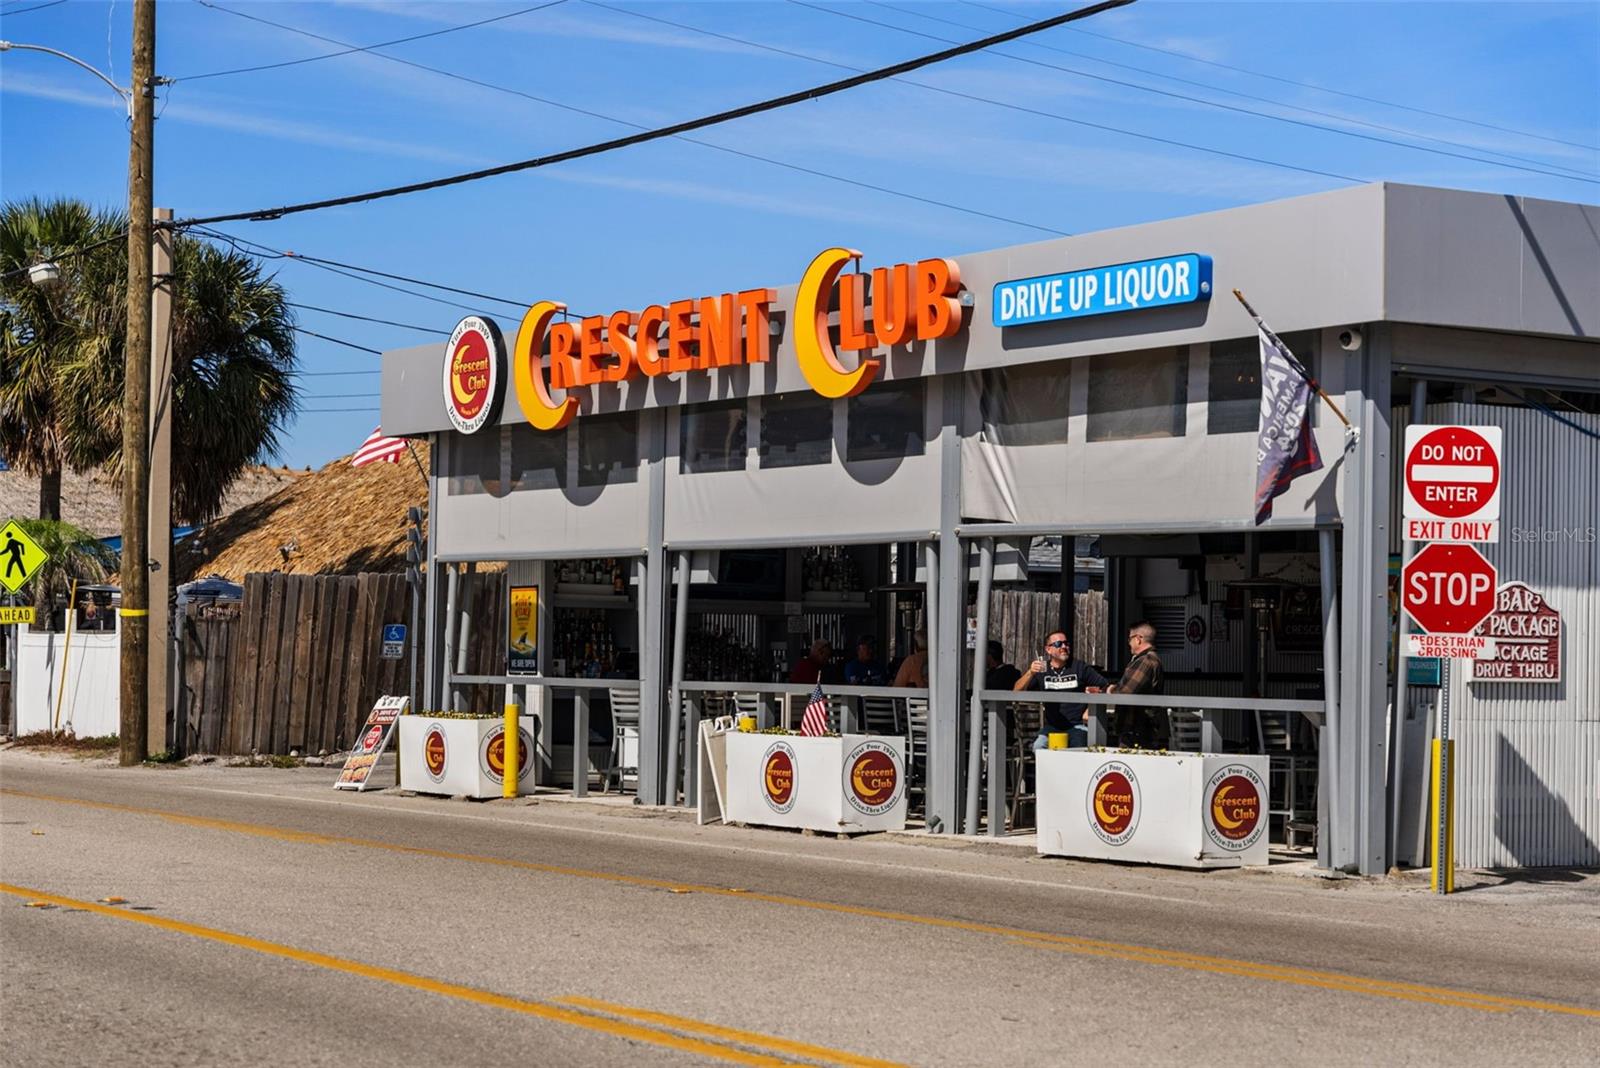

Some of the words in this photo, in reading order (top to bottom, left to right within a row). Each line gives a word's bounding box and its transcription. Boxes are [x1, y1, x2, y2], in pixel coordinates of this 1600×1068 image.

[1001, 279, 1063, 321] DRIVE
[1069, 274, 1098, 311] UP
[1104, 261, 1190, 308] LIQUOR
[514, 288, 774, 430] CRESCENT
[793, 247, 961, 399] CLUB
[453, 357, 488, 374] Crescent
[468, 374, 487, 390] Club
[1422, 445, 1444, 461] DO
[1452, 446, 1484, 462] NOT
[1426, 486, 1478, 502] ENTER
[1409, 521, 1446, 539] EXIT
[1452, 522, 1492, 540] ONLY
[1408, 572, 1490, 607] STOP
[1500, 587, 1541, 613] BAR
[1285, 624, 1321, 634] CRESCE
[1490, 615, 1559, 637] PACKAGE
[1418, 647, 1478, 658] CROSSING
[1494, 645, 1548, 661] ACKAGE
[1476, 662, 1512, 677] DRIVE
[1517, 664, 1554, 678] THRU
[852, 747, 864, 760] First
[767, 768, 792, 777] Crescent
[854, 767, 894, 778] Crescent
[1212, 772, 1226, 786] First
[776, 778, 790, 788] Club
[872, 778, 892, 788] Club
[1096, 790, 1132, 803] Crescent
[1214, 795, 1257, 807] Crescent
[1110, 804, 1130, 816] Club
[1233, 808, 1256, 820] Club
[1210, 828, 1242, 848] Drive-Thru
[1243, 828, 1260, 847] Liquor
